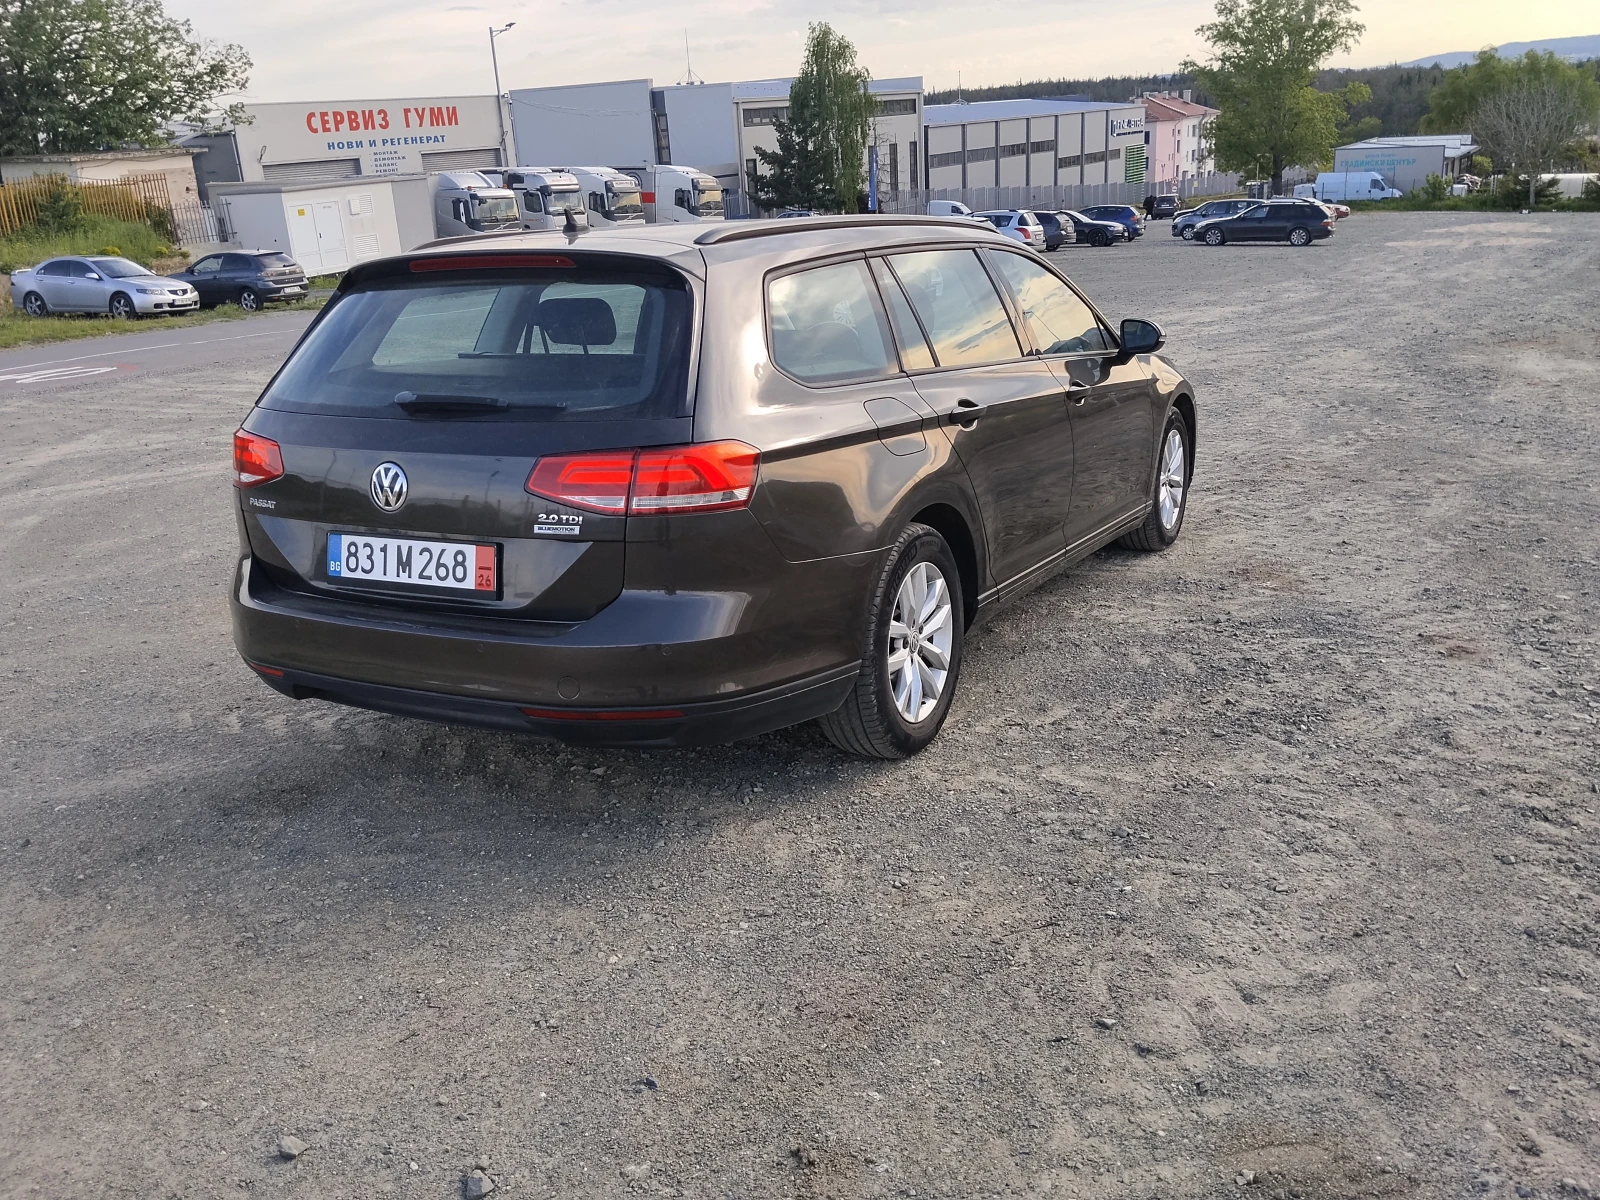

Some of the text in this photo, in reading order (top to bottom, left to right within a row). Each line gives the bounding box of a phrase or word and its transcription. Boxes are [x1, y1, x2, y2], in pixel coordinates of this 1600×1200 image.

[306, 106, 459, 134] СЕРВИЗ ГУМИ
[327, 135, 446, 150] НОВИ И РЕГЕНЕРАТ
[1340, 158, 1417, 167] ГРАДИНСКИ ЦЕНТЪР
[249, 498, 277, 509] PASSAT
[538, 513, 583, 525] 2.0 TDI
[330, 561, 341, 572] BG
[478, 574, 492, 587] 26
